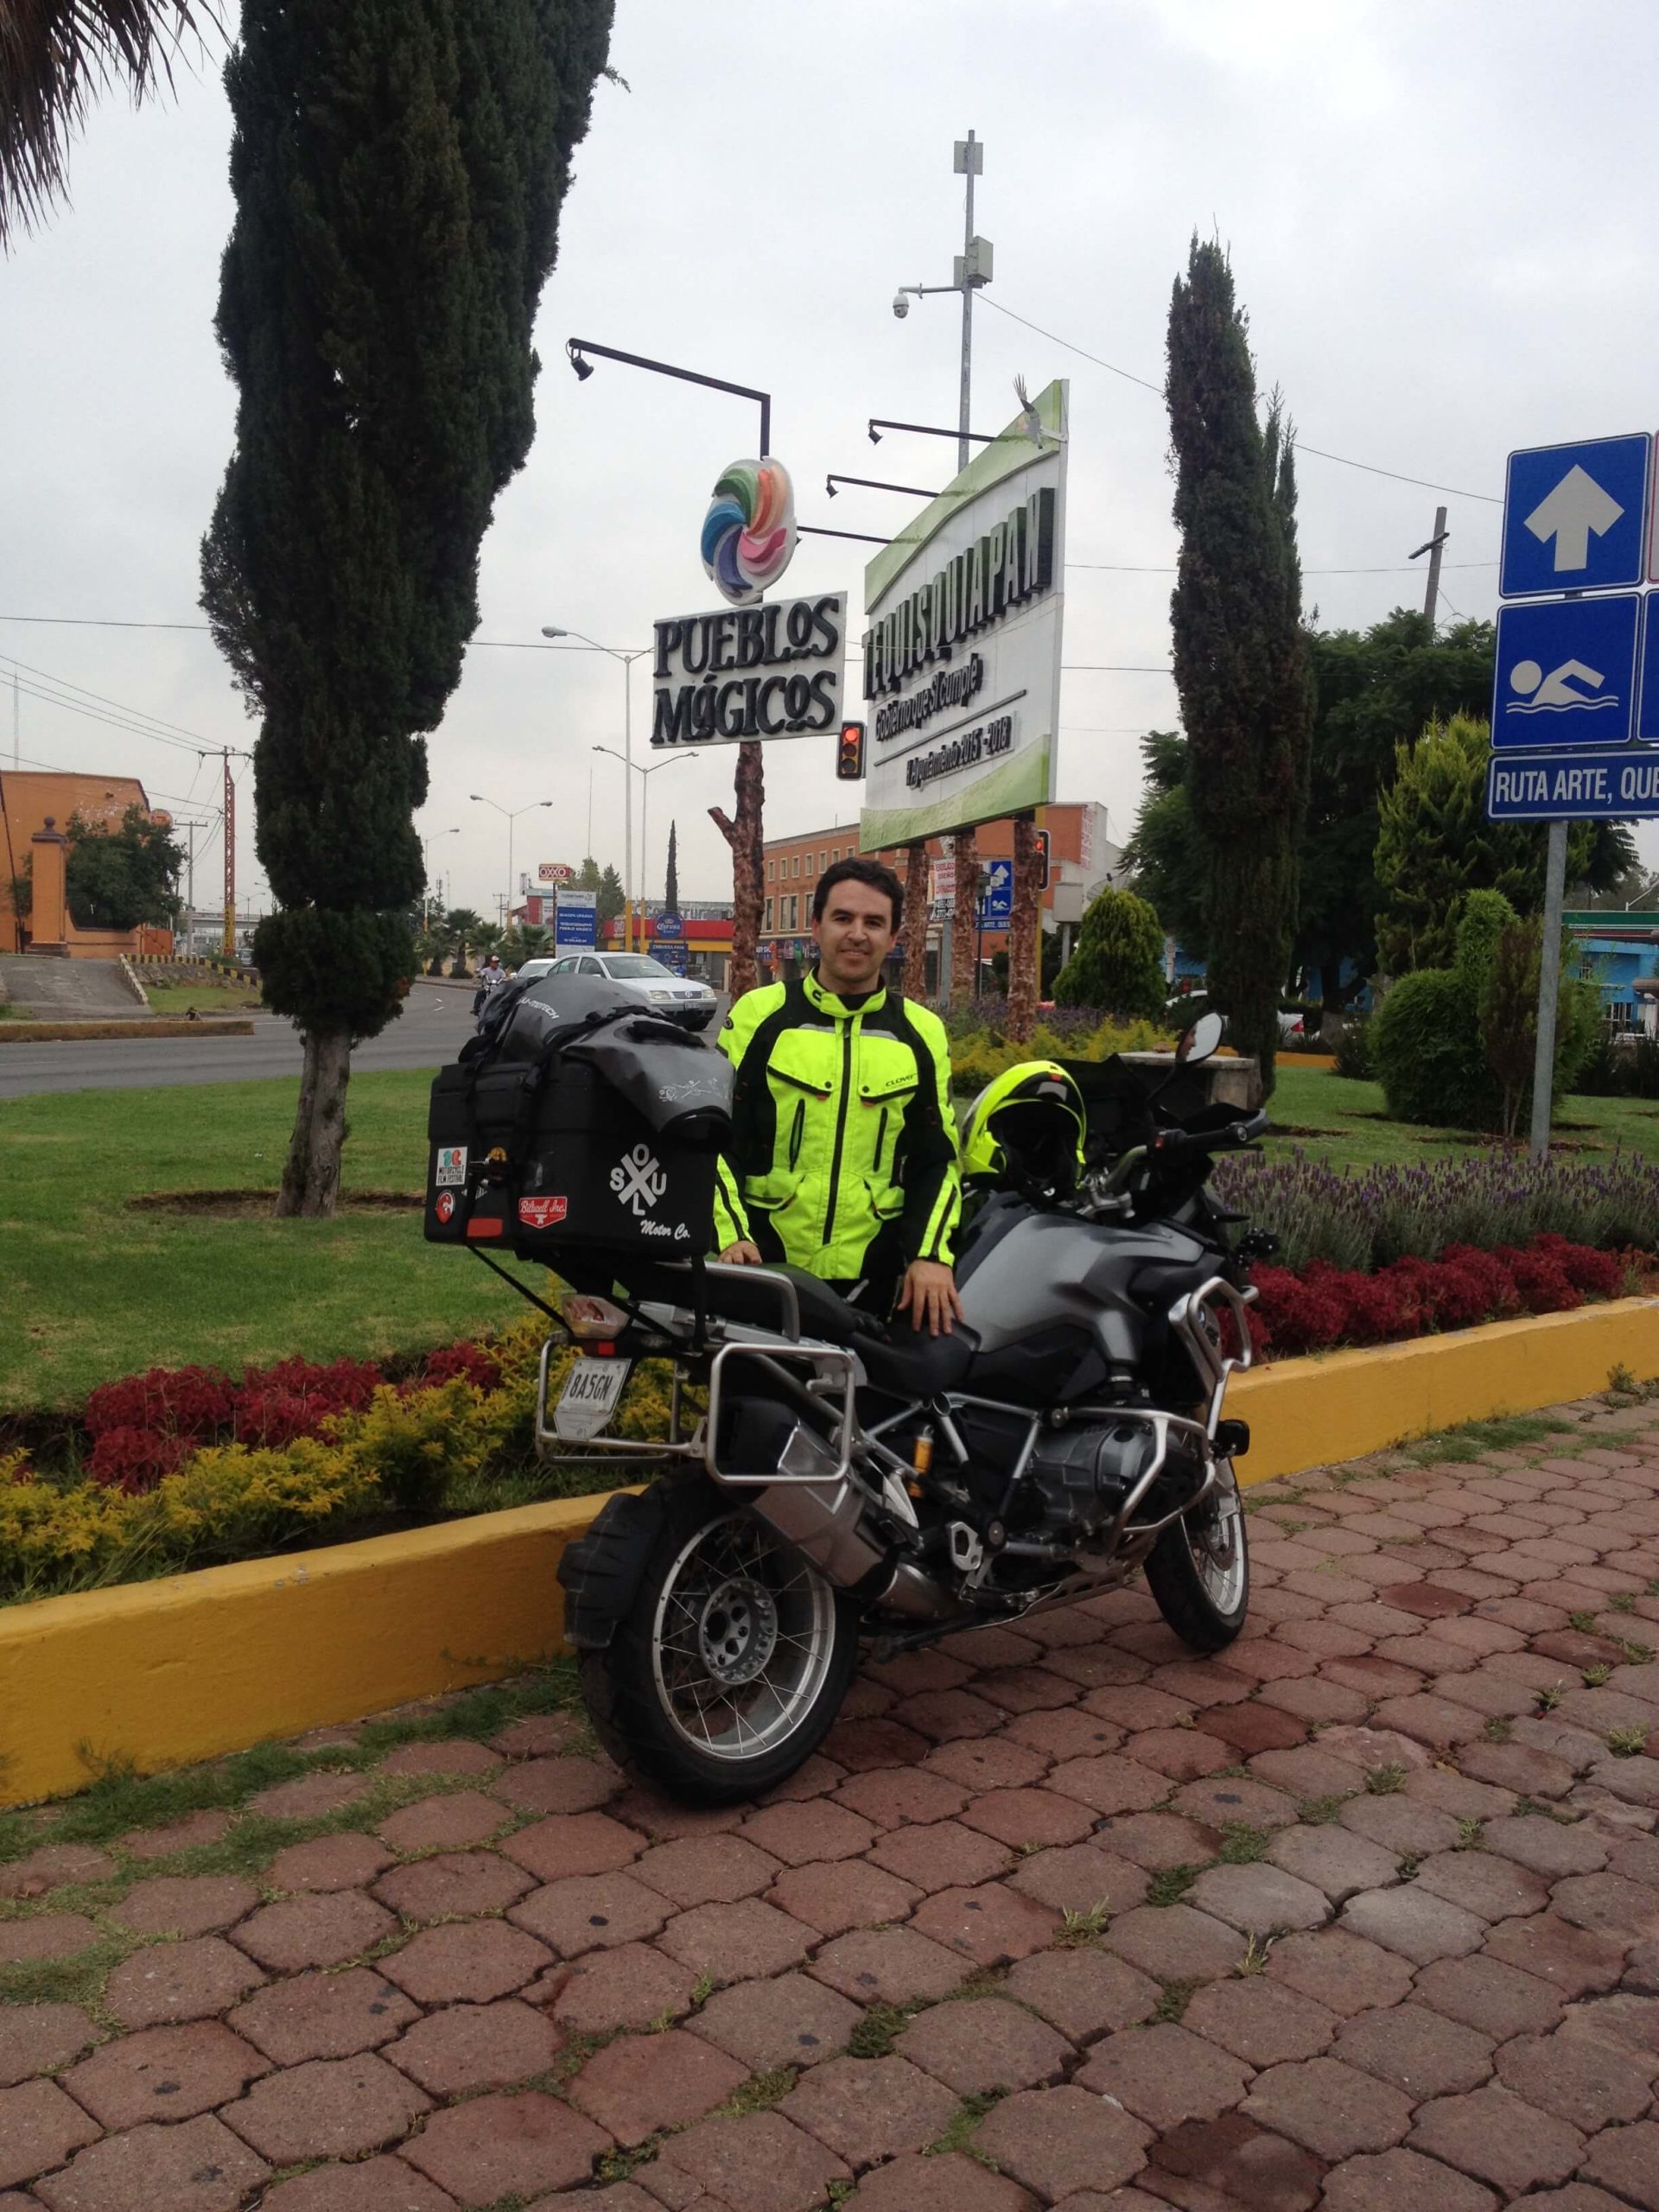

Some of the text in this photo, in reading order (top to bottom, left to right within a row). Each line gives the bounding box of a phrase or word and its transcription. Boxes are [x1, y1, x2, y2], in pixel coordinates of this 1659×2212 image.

[861, 486, 1055, 700] TEQUISQUIAPAN
[652, 596, 839, 678] PUEBLOS
[875, 699, 913, 742] Gobierno
[912, 688, 931, 728] que
[939, 652, 983, 708] cumple
[987, 715, 1012, 755] 2018
[1495, 771, 1548, 803] RUTA
[1553, 768, 1612, 804] ARTE,
[539, 868, 567, 878] OXXO
[639, 1219, 690, 1240] Motor Co.
